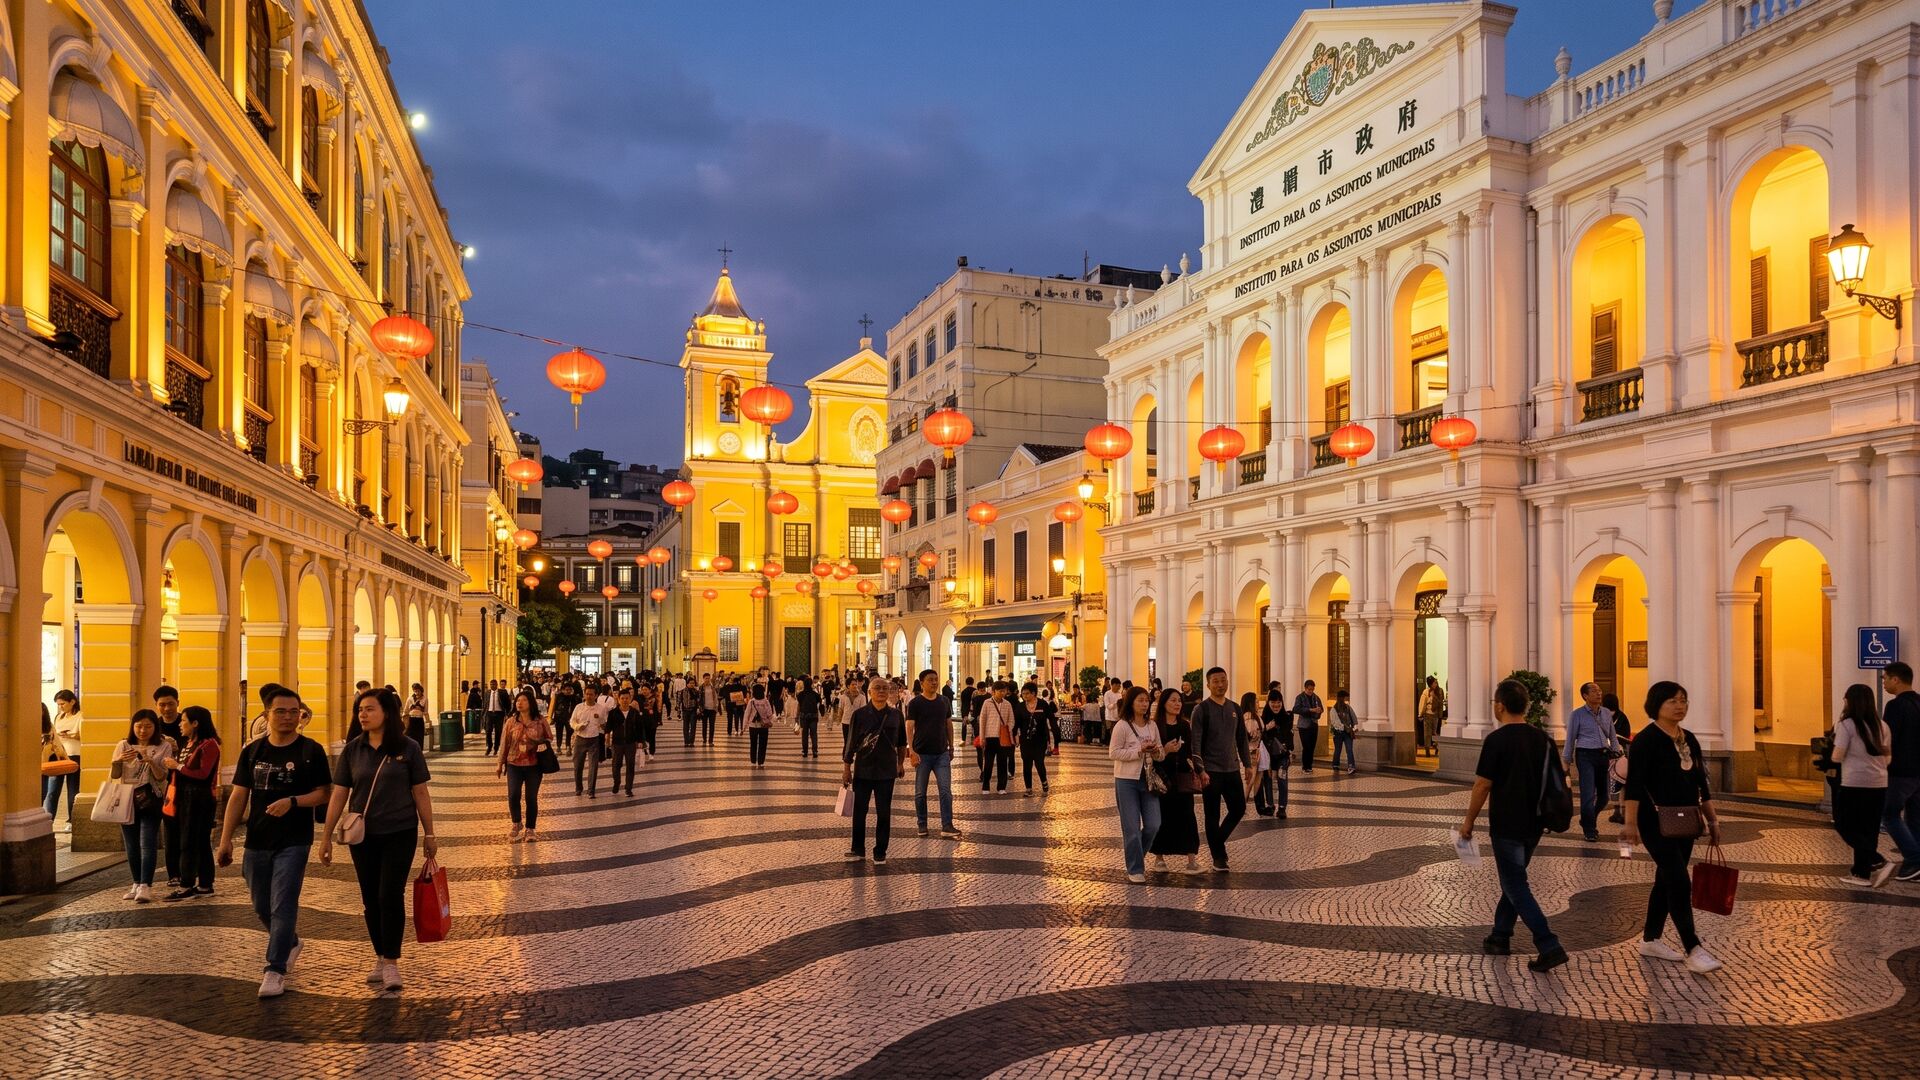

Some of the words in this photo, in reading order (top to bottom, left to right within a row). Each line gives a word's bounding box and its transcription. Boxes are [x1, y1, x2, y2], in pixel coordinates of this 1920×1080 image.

[1235, 269, 1277, 299] INSTITUTO
[1280, 257, 1304, 277] PARA
[1307, 249, 1320, 264] OS
[1323, 225, 1373, 258] ASSUNTOS
[1377, 192, 1442, 233] MUNICIPAIS
[1240, 220, 1281, 250] INSTITUTO
[1283, 207, 1306, 227] PARA
[1309, 199, 1321, 213] OS
[1325, 171, 1372, 207] ASSUNTOS
[1376, 138, 1435, 179] MUNICIPAIS
